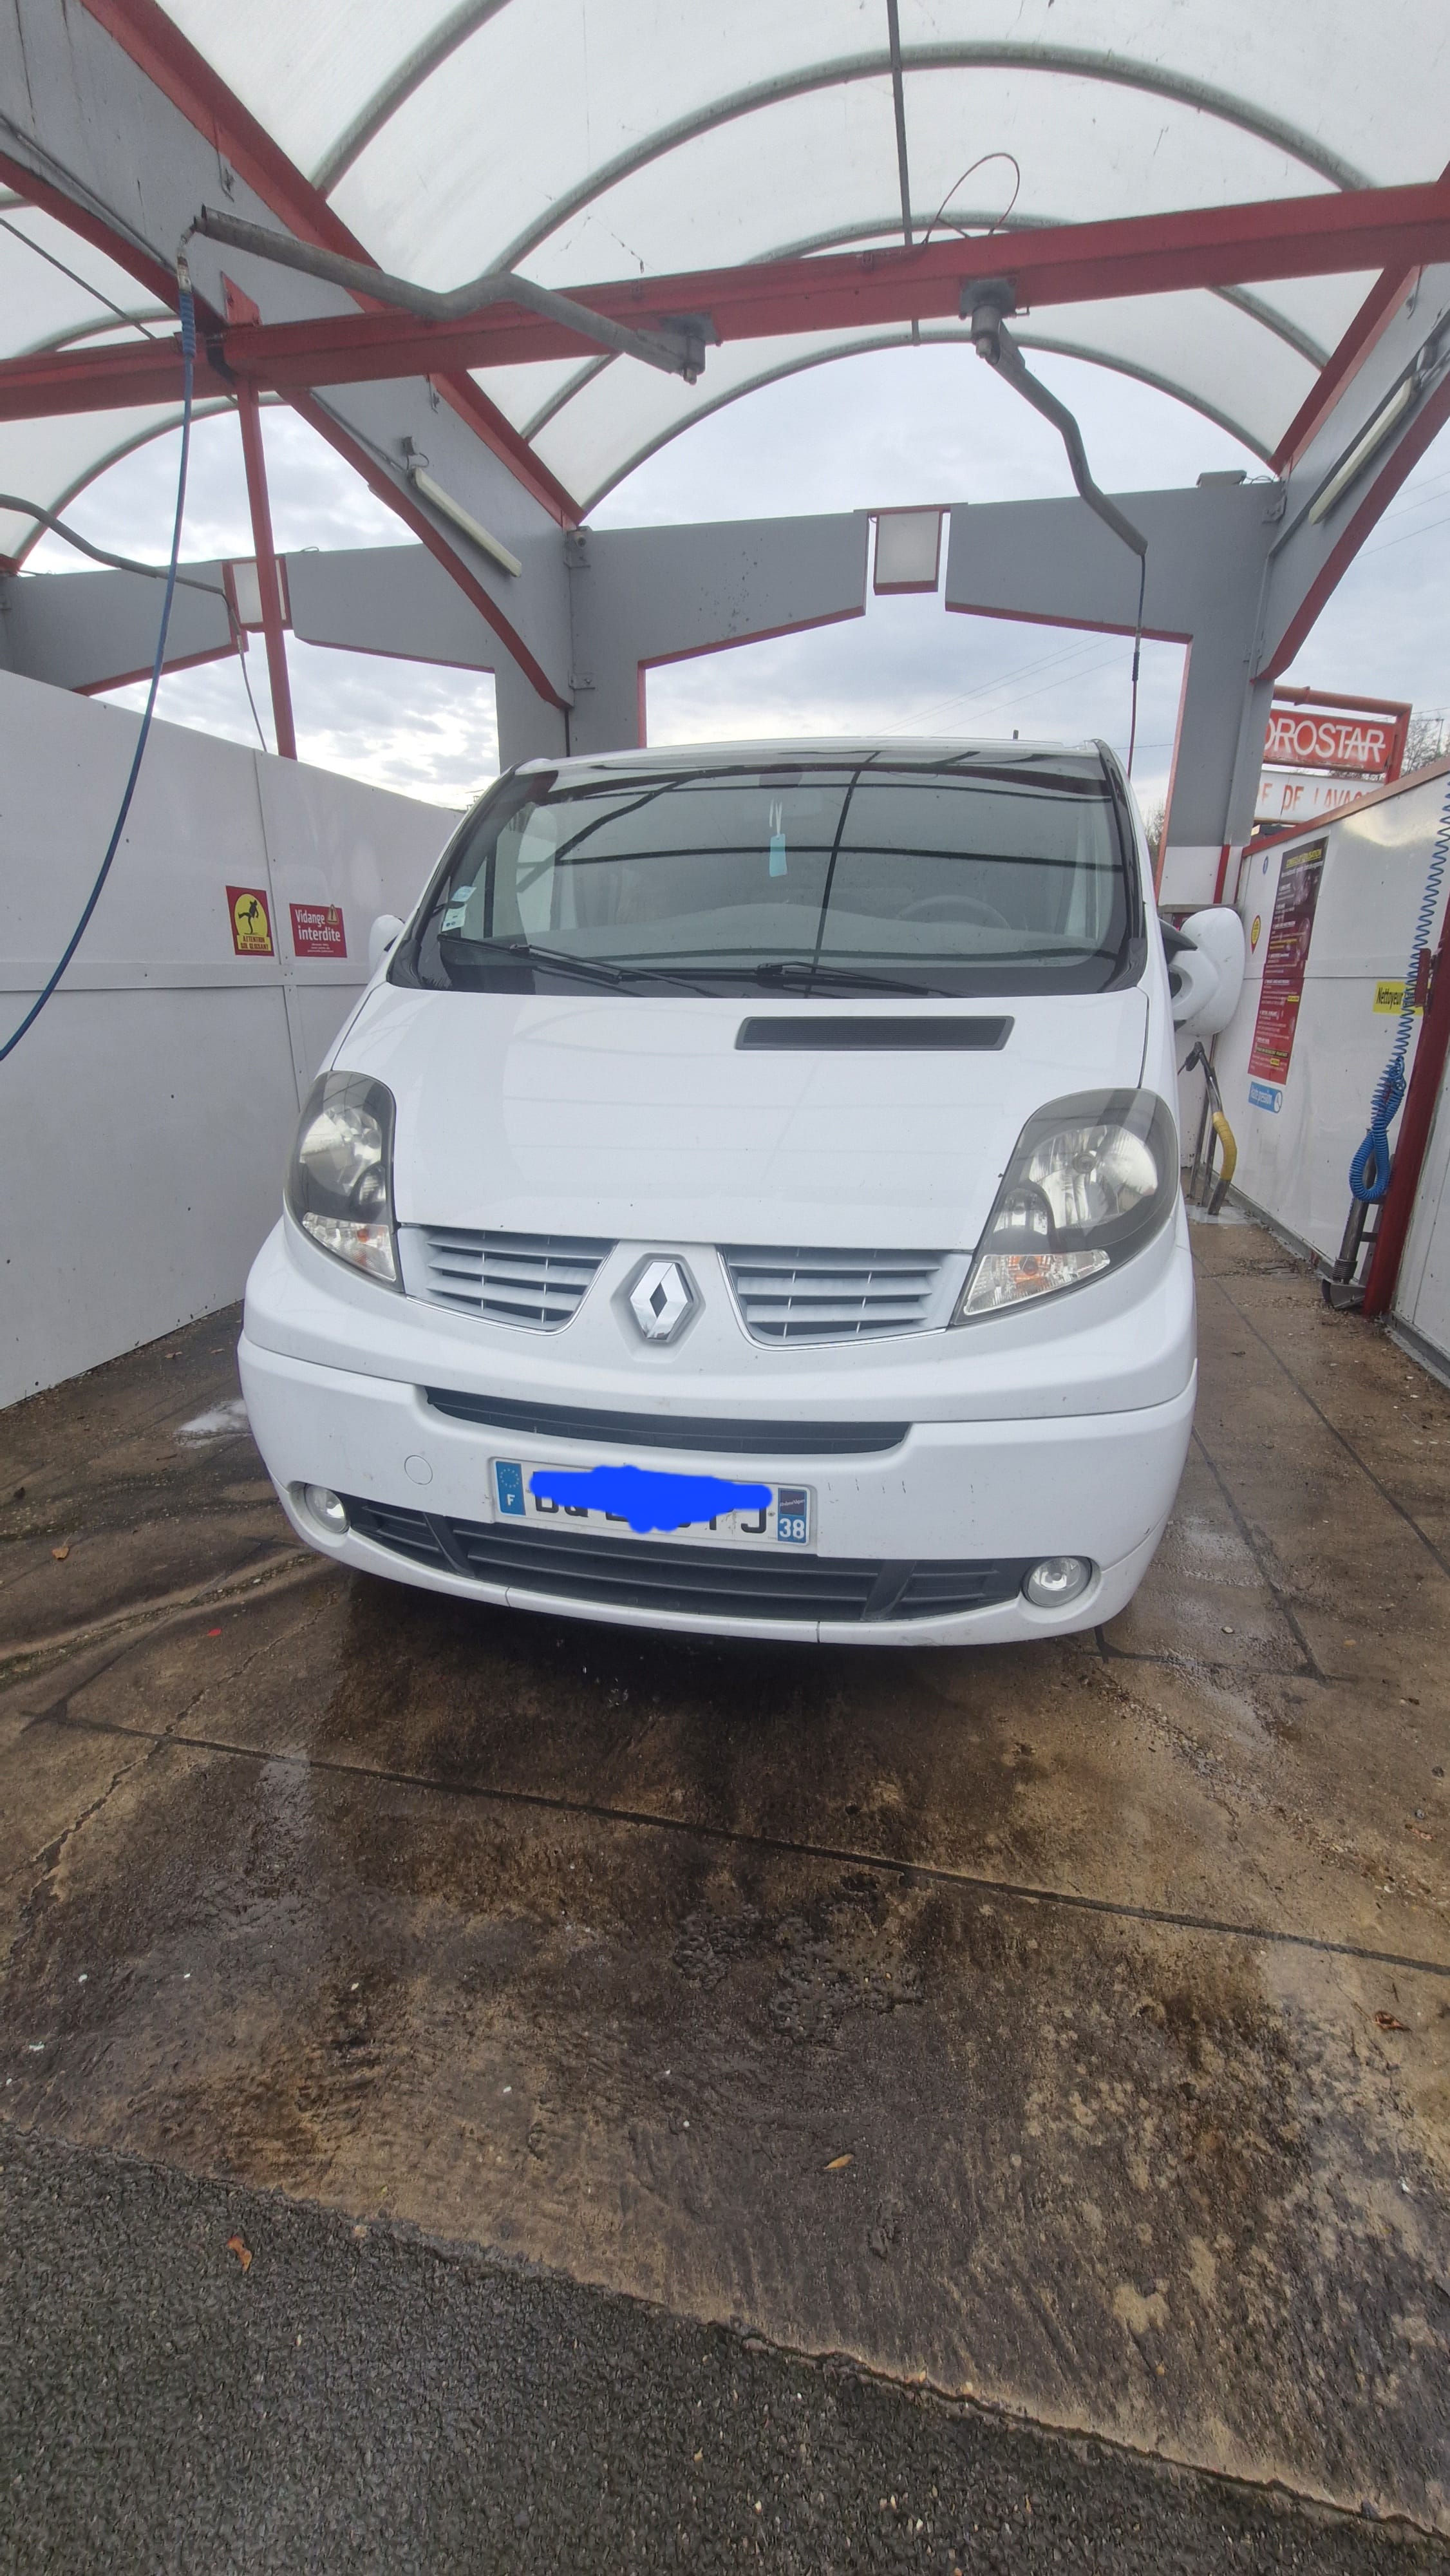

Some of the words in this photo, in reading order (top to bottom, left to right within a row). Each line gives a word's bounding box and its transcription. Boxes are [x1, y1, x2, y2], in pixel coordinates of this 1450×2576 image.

[295, 909, 325, 927] Vidange
[298, 925, 341, 942] interdite
[1376, 987, 1404, 1010] Nettoyeur
[506, 1494, 515, 1506] F
[779, 1517, 805, 1539] 38
